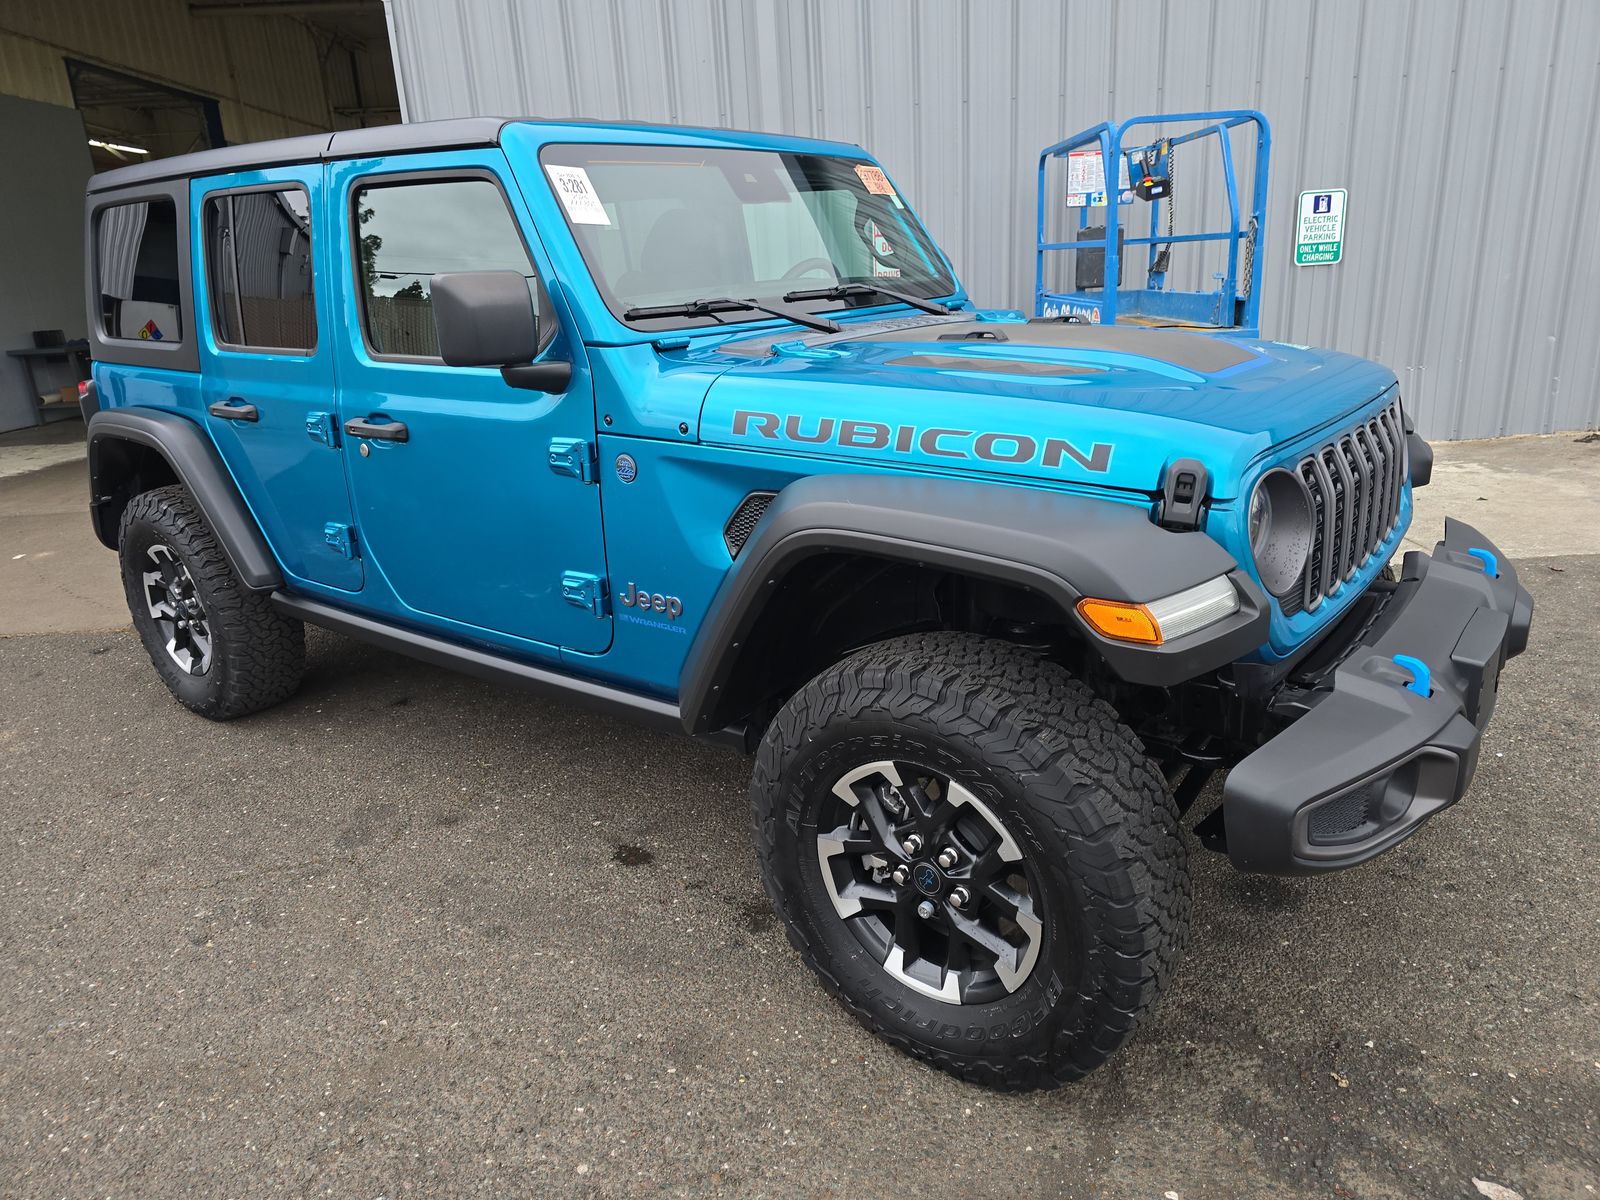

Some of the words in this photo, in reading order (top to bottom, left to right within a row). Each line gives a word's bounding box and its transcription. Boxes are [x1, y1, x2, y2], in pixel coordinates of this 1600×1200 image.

[1304, 215, 1339, 225] ELECTRIC
[1305, 224, 1337, 233] VEHICLE
[1303, 233, 1337, 242] PARKING
[1300, 245, 1317, 253] ONLY
[1319, 244, 1339, 252] WHILE
[1302, 252, 1335, 262] CHARGING
[731, 409, 1114, 475] RUBICON
[619, 582, 683, 620] Jeep
[629, 615, 687, 634] WRANGLER
